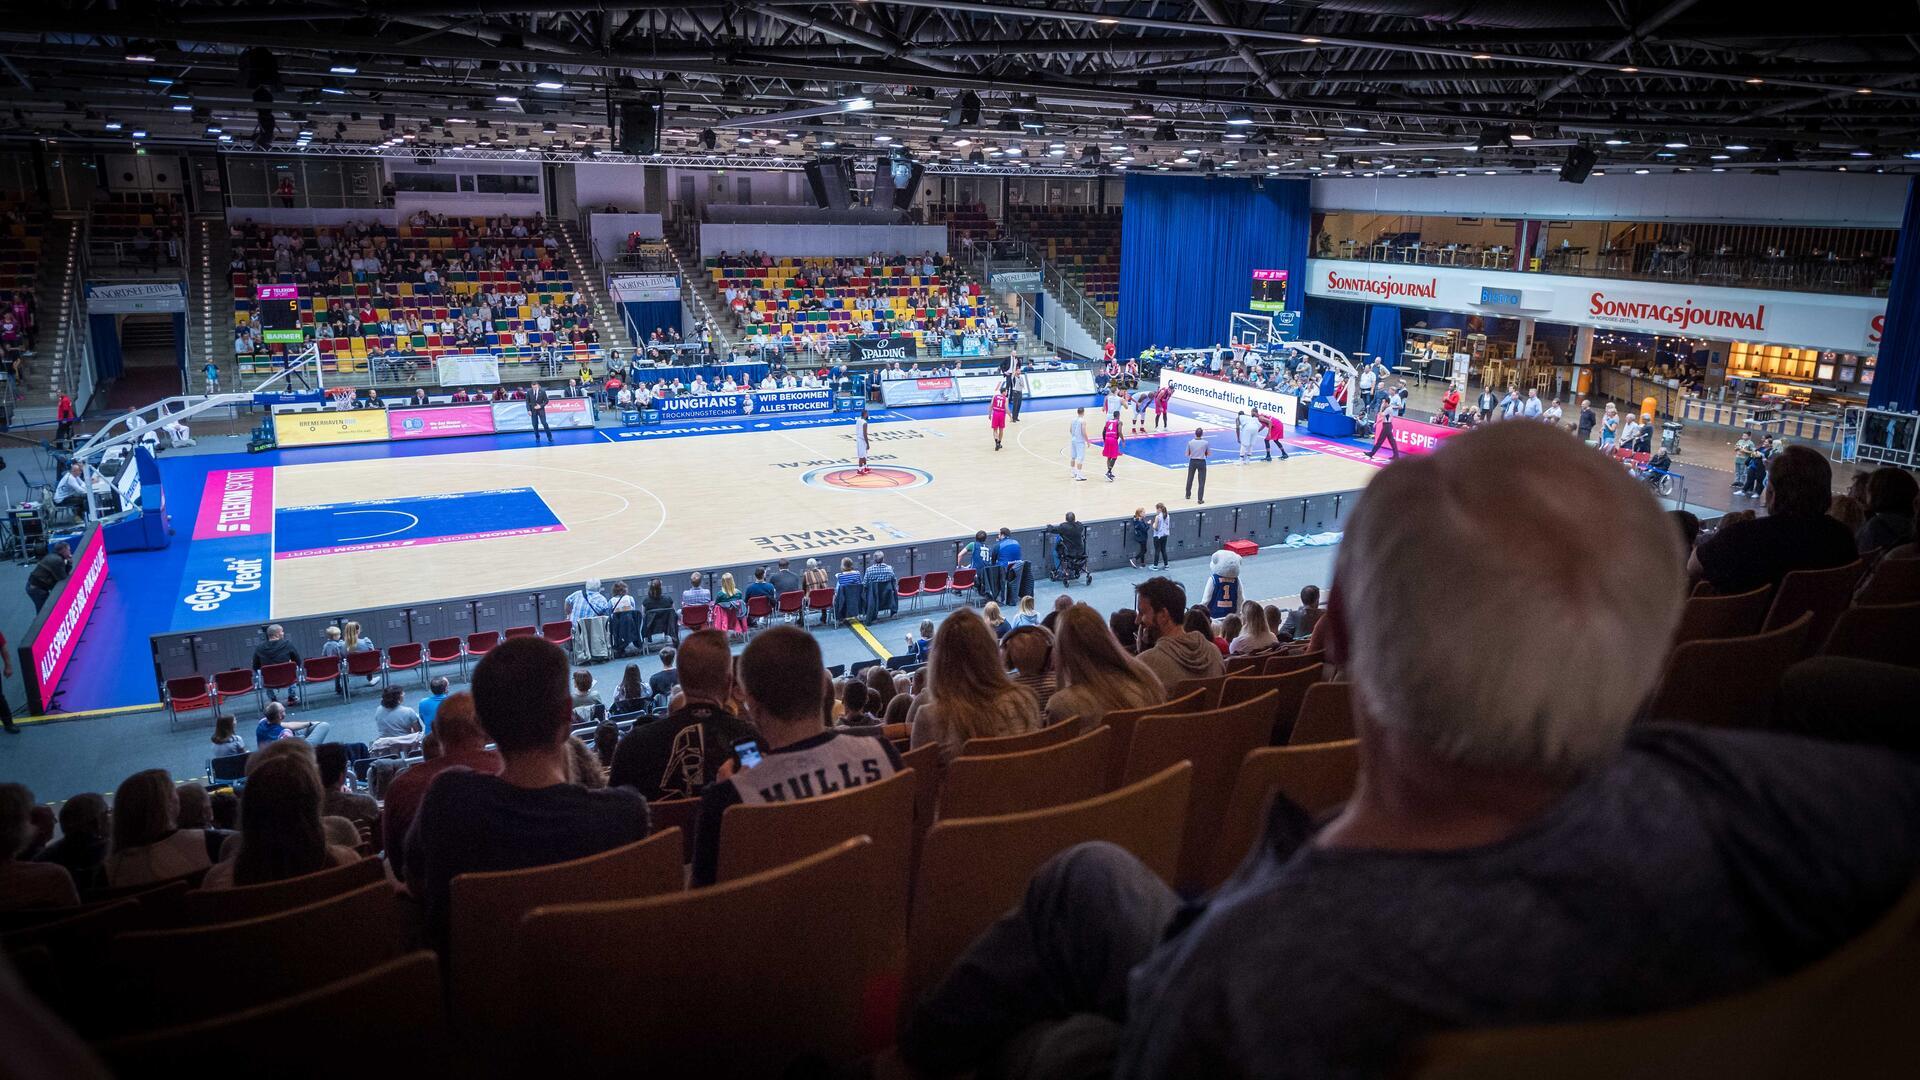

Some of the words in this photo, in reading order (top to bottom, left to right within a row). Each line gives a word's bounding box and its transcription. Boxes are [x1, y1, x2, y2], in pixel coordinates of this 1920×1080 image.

[861, 346, 905, 360] SPALDING
[662, 397, 737, 411] JUNGHANS
[759, 394, 777, 402] WIR
[780, 391, 829, 400] BEKOMMEN
[1167, 379, 1245, 405] Genossenschaftlich
[1247, 397, 1286, 415] beraten.
[662, 409, 737, 418] TROCKNUNGSTECHNIK
[759, 404, 786, 412] ALLES
[787, 401, 829, 410] TROCKEN!
[225, 471, 255, 490] SPORT
[219, 490, 253, 523] TELEKOM
[749, 526, 869, 546] FINALE
[761, 533, 875, 553] ACHTEL
[41, 643, 57, 685] ALLE
[53, 614, 72, 659] SPIELE
